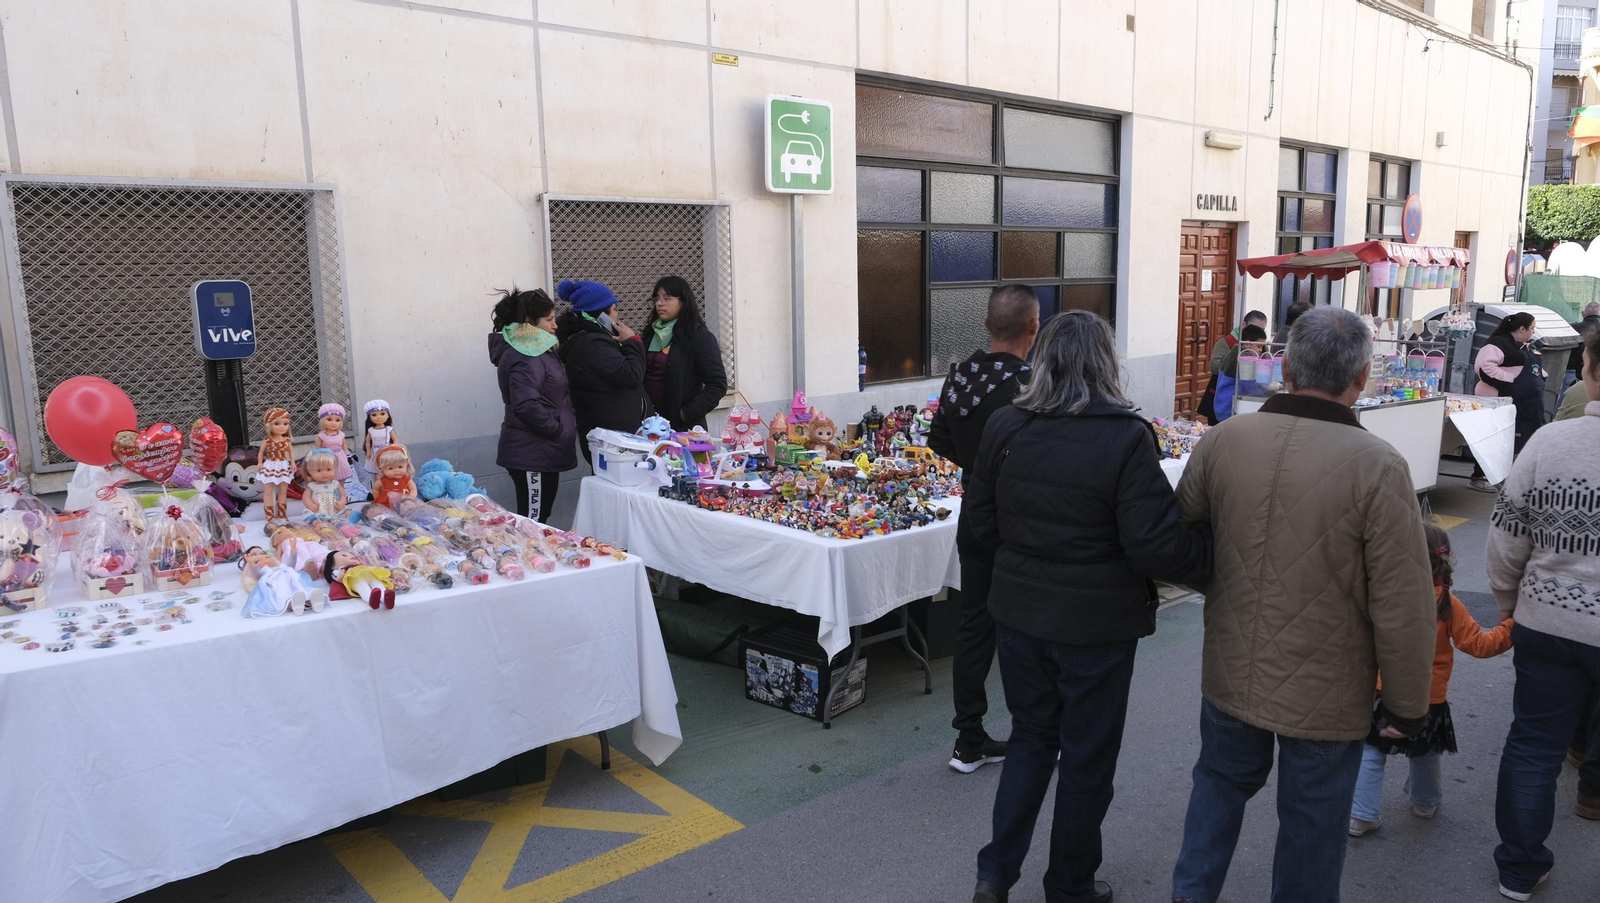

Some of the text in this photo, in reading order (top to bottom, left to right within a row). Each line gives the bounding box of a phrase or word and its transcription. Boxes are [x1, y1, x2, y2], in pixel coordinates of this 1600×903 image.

[1196, 193, 1238, 212] CAPILLA
[155, 438, 176, 447] amo
[123, 454, 139, 464] por
[531, 488, 539, 504] FILA
[531, 508, 539, 520] FIL
